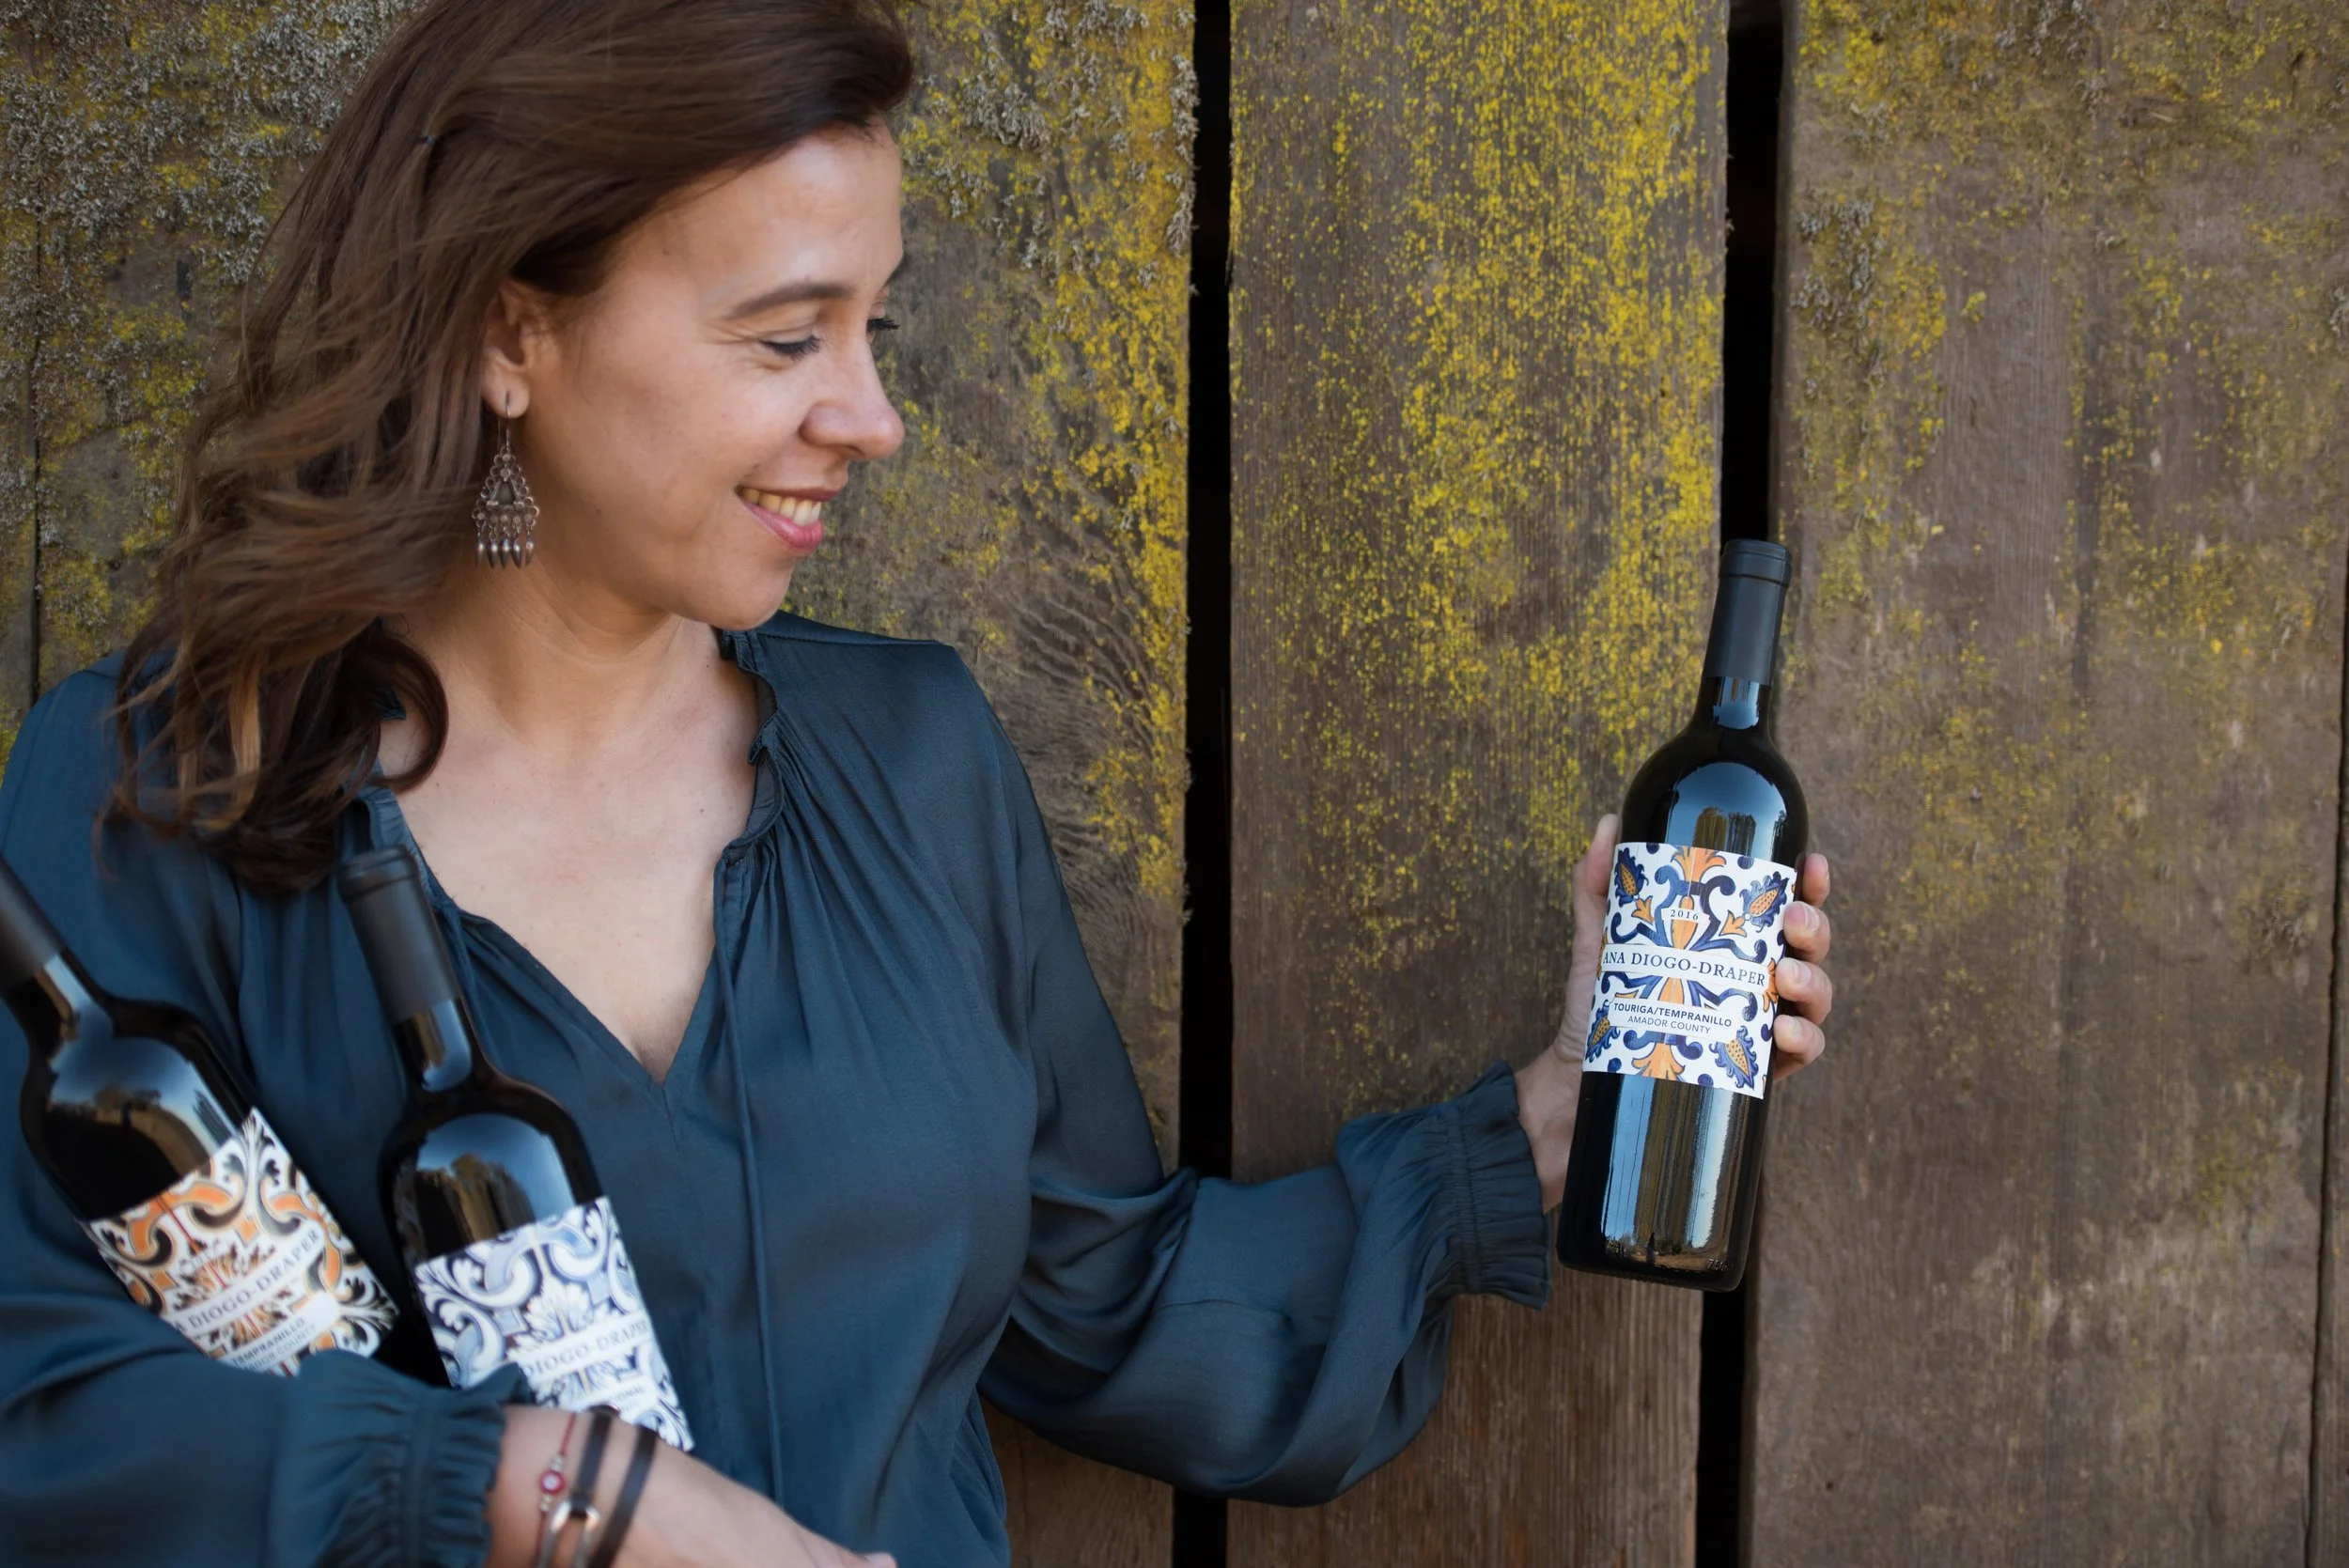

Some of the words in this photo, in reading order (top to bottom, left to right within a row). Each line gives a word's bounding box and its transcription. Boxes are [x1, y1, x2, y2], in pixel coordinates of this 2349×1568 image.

[1670, 908, 1699, 921] 2016
[1603, 952, 1626, 964] ANA
[1631, 952, 1766, 986] DIOGO-DRAPER
[1613, 1002, 1732, 1027] TOURIGA/TEMPRANILLO
[1627, 1016, 1668, 1028] AMADOR
[1670, 1020, 1711, 1034] COUNTY
[188, 1228, 320, 1329] DIOGO-DRAPER
